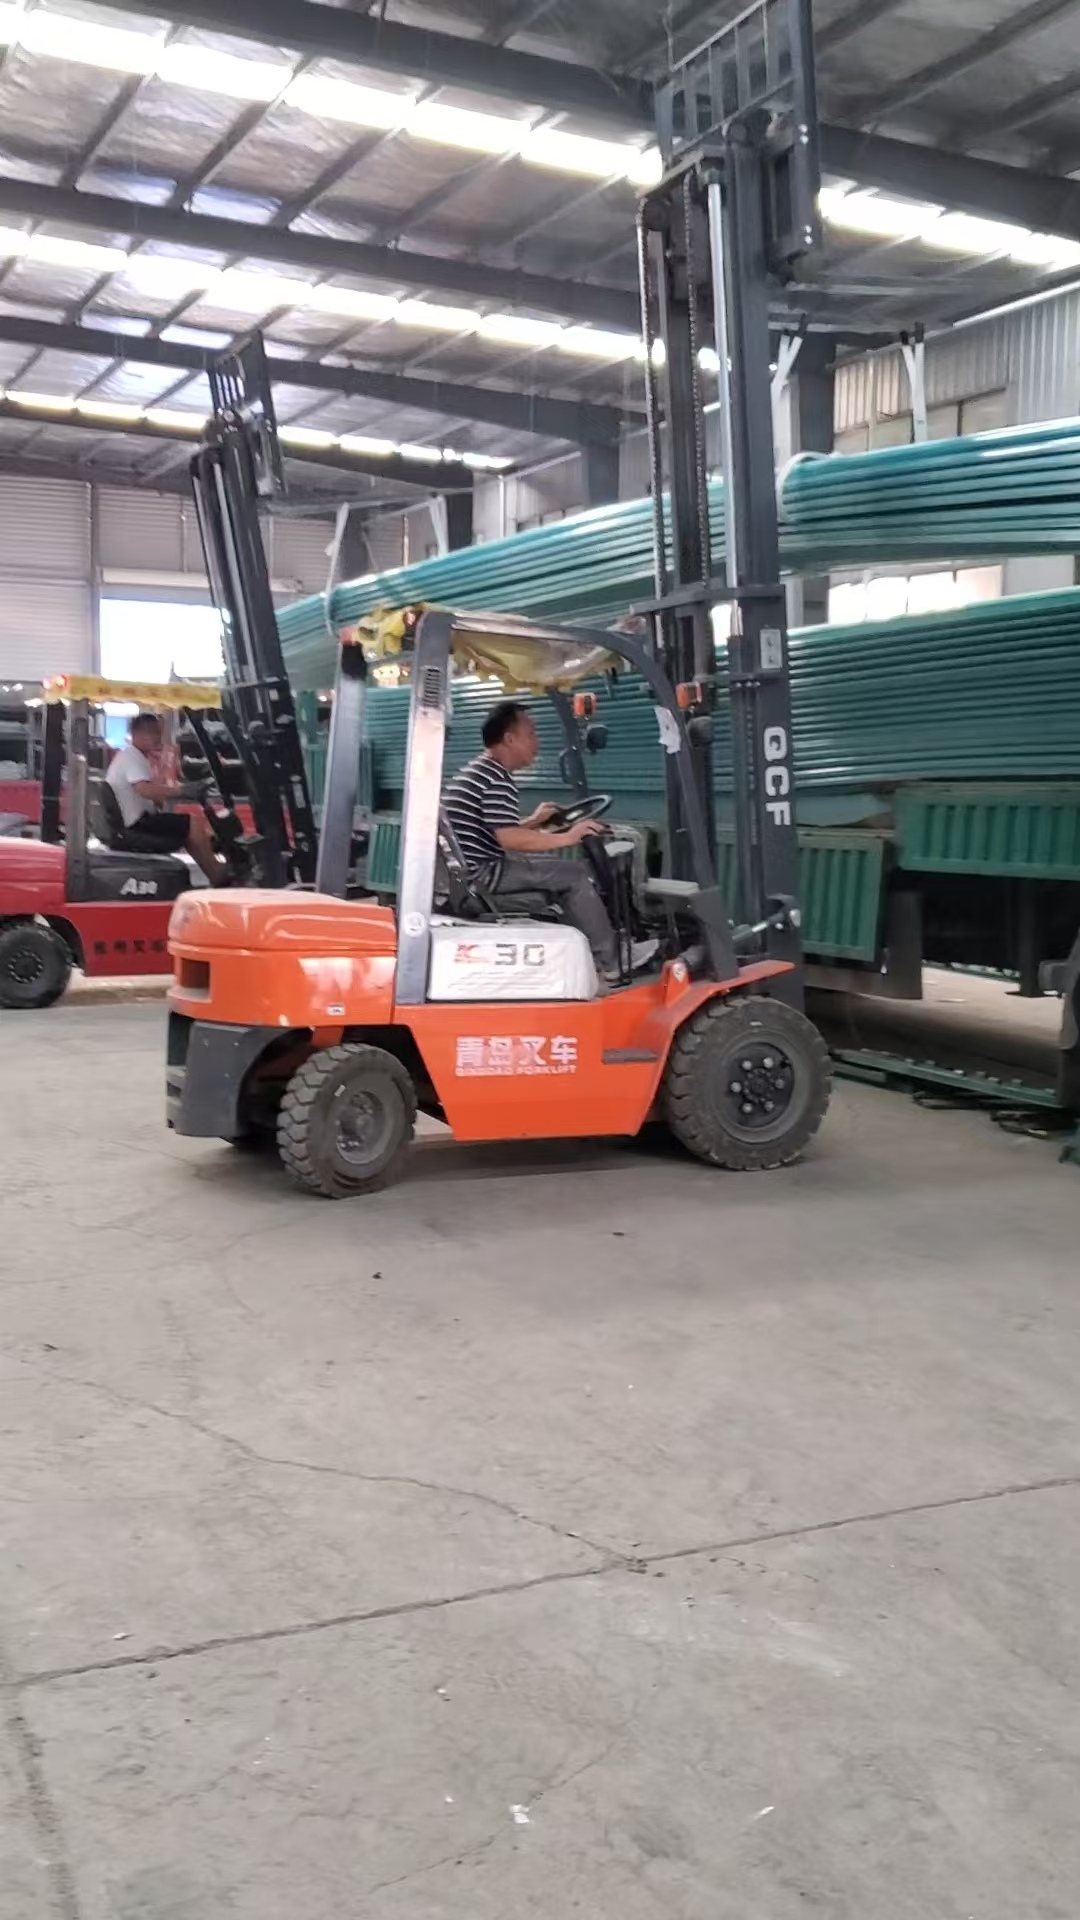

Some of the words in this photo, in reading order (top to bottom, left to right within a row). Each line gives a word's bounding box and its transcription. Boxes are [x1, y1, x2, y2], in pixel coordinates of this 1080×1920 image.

[763, 726, 791, 825] QCF
[456, 1035, 578, 1066] 青岛叉车
